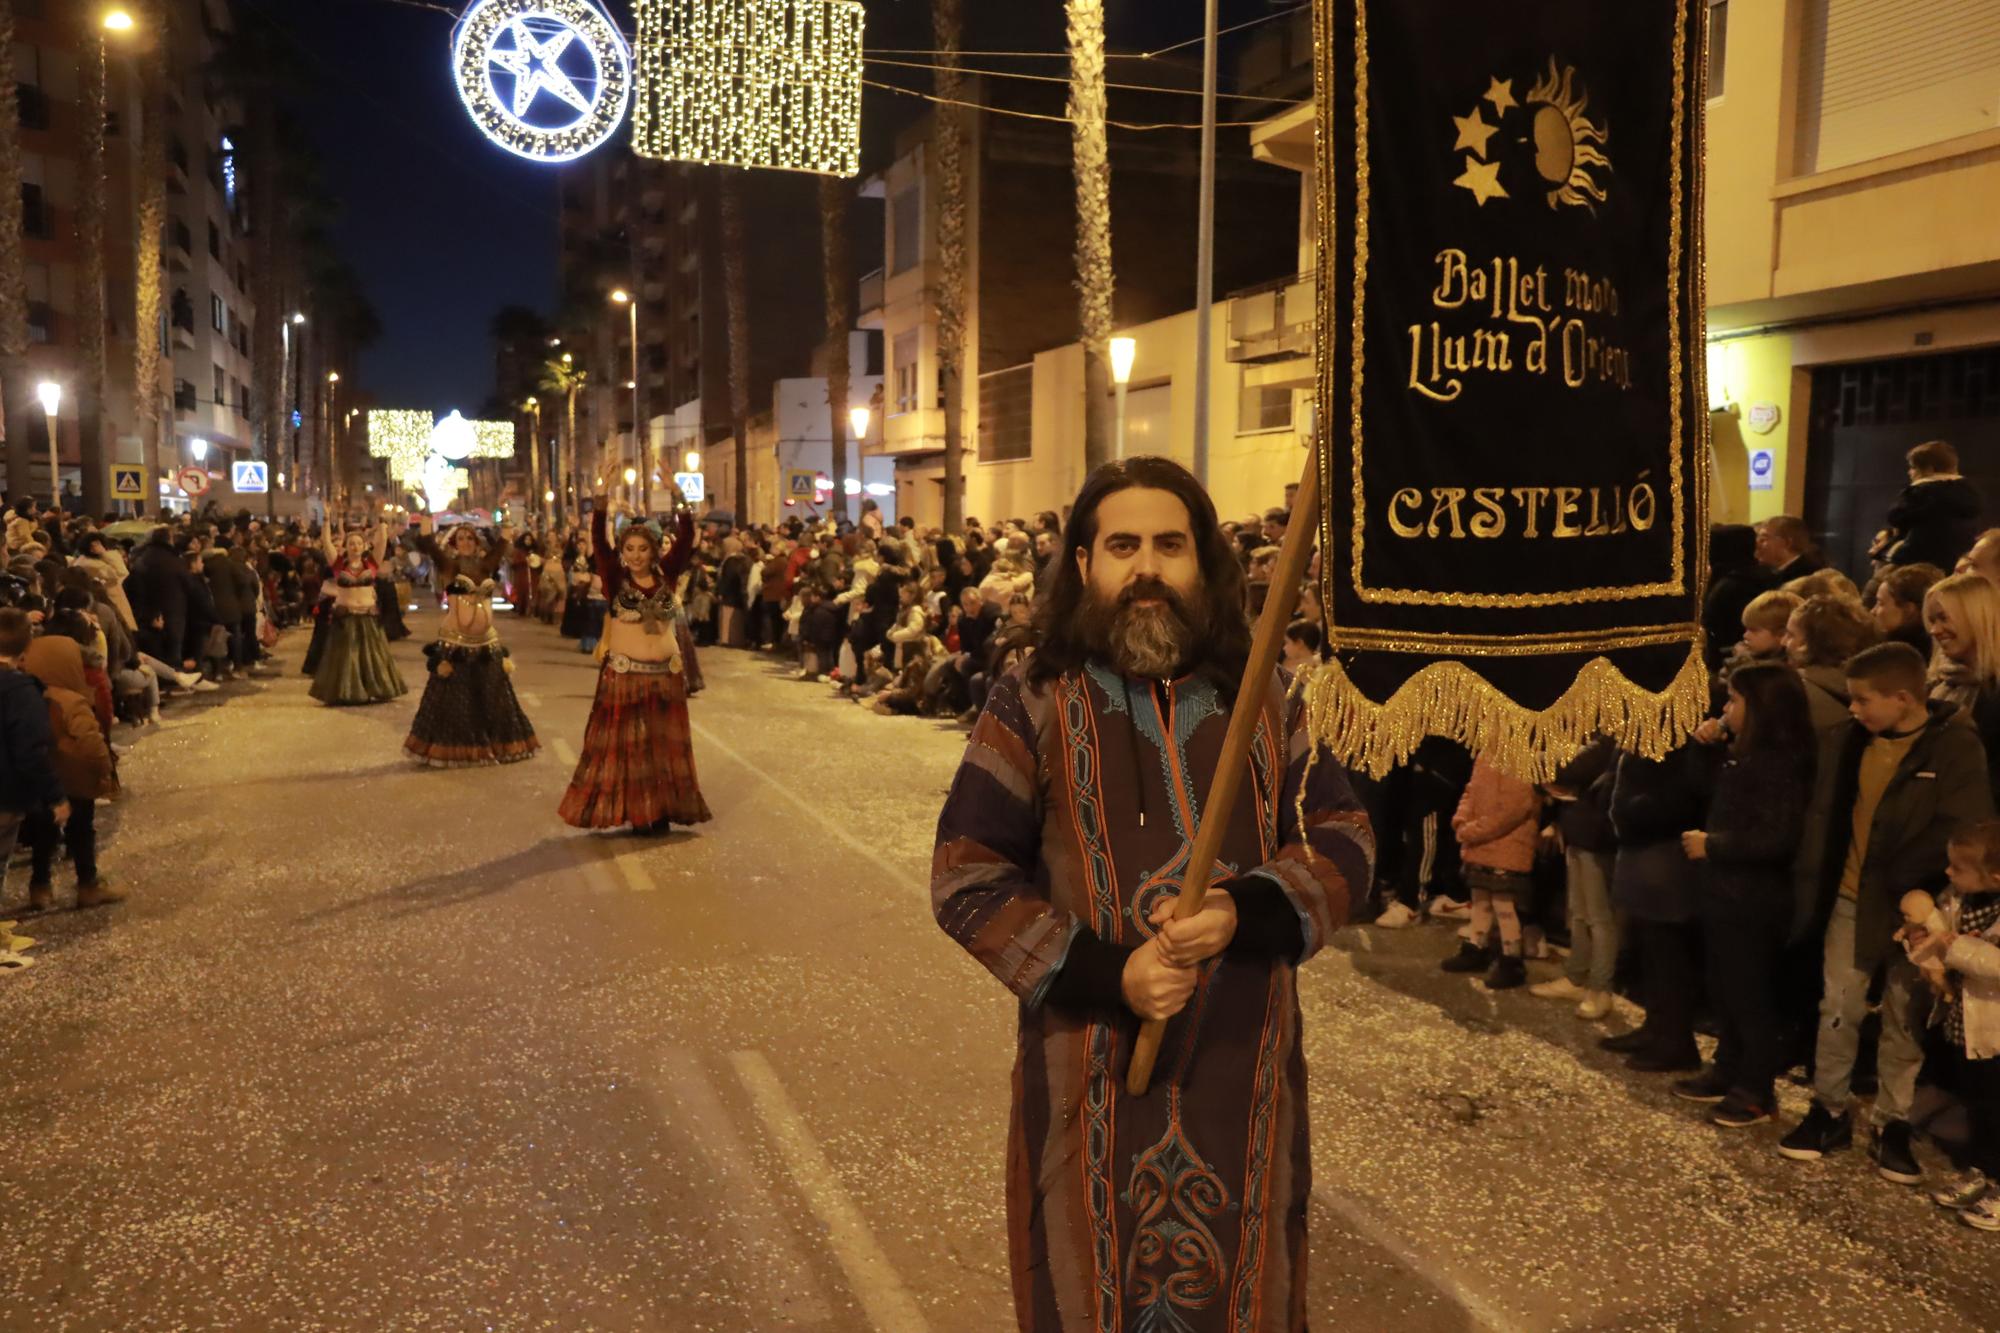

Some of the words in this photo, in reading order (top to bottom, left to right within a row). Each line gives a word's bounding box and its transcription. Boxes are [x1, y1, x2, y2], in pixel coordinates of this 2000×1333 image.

[1433, 248, 1551, 322] Ballet
[1407, 321, 1513, 401] Llum
[1387, 469, 1656, 539] CASTELLÓ
